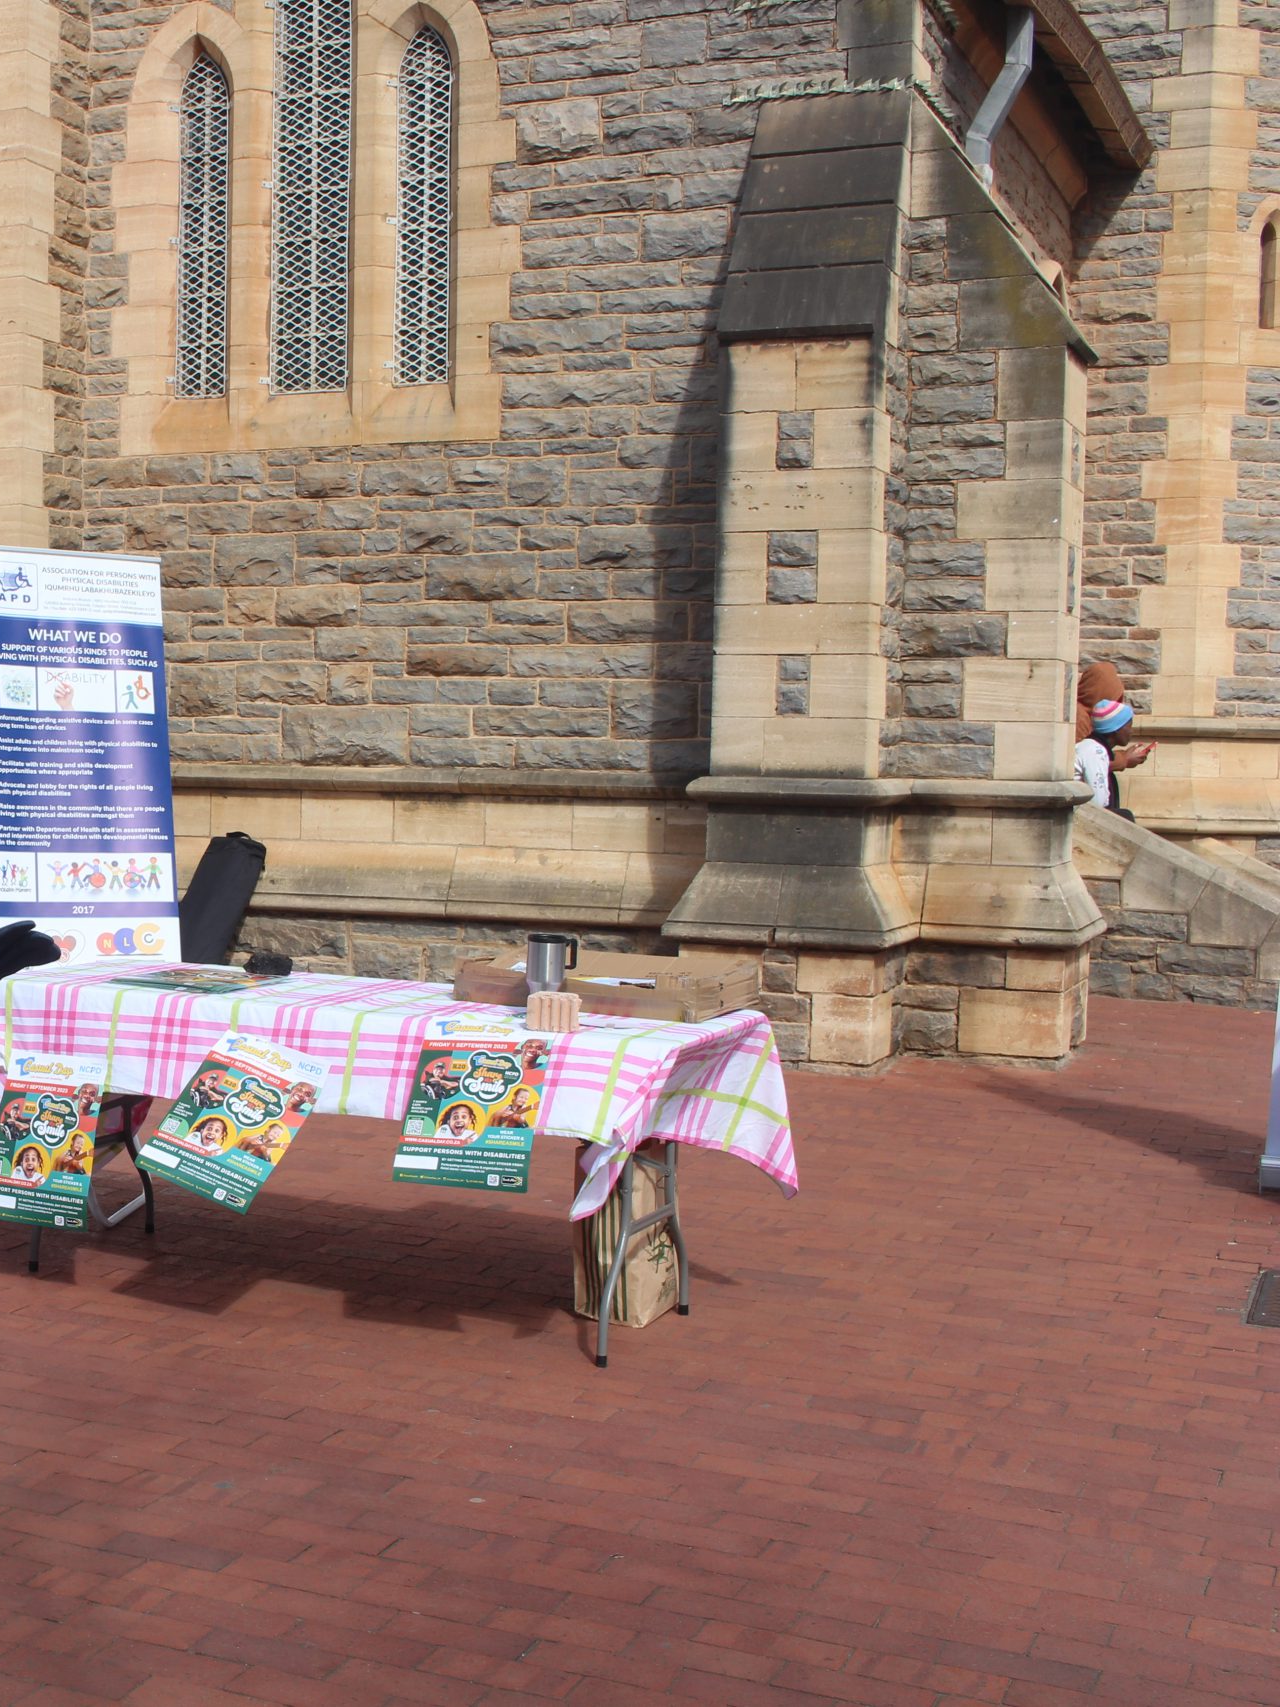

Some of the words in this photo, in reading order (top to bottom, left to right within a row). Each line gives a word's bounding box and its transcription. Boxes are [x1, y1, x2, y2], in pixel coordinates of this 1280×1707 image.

[42, 567, 89, 576] ASSOCIATION
[96, 579, 138, 587] DISABILITIES
[29, 629, 71, 641] WHAT
[74, 631, 96, 643] WE
[100, 633, 121, 644] DO
[2, 644, 36, 652] SUPPORT
[41, 655, 77, 663] PHYSICAL
[72, 906, 95, 914] 2017
[429, 1041, 450, 1049] FRIDAY
[456, 1042, 491, 1051] SEPTEMBER
[212, 1053, 230, 1063] FRIDAY
[234, 1061, 267, 1080] SEPTEMBER
[267, 1075, 281, 1085] 2023
[464, 1077, 506, 1094] Smile
[34, 1121, 65, 1137] Smile
[152, 1140, 178, 1152] SUPPORT
[178, 1150, 205, 1167] PERSONS
[205, 1162, 221, 1172] WITH
[221, 1168, 257, 1187] DISABILITIES
[11, 1188, 35, 1197] PERSONS
[50, 1194, 84, 1204] DISABILITIES
